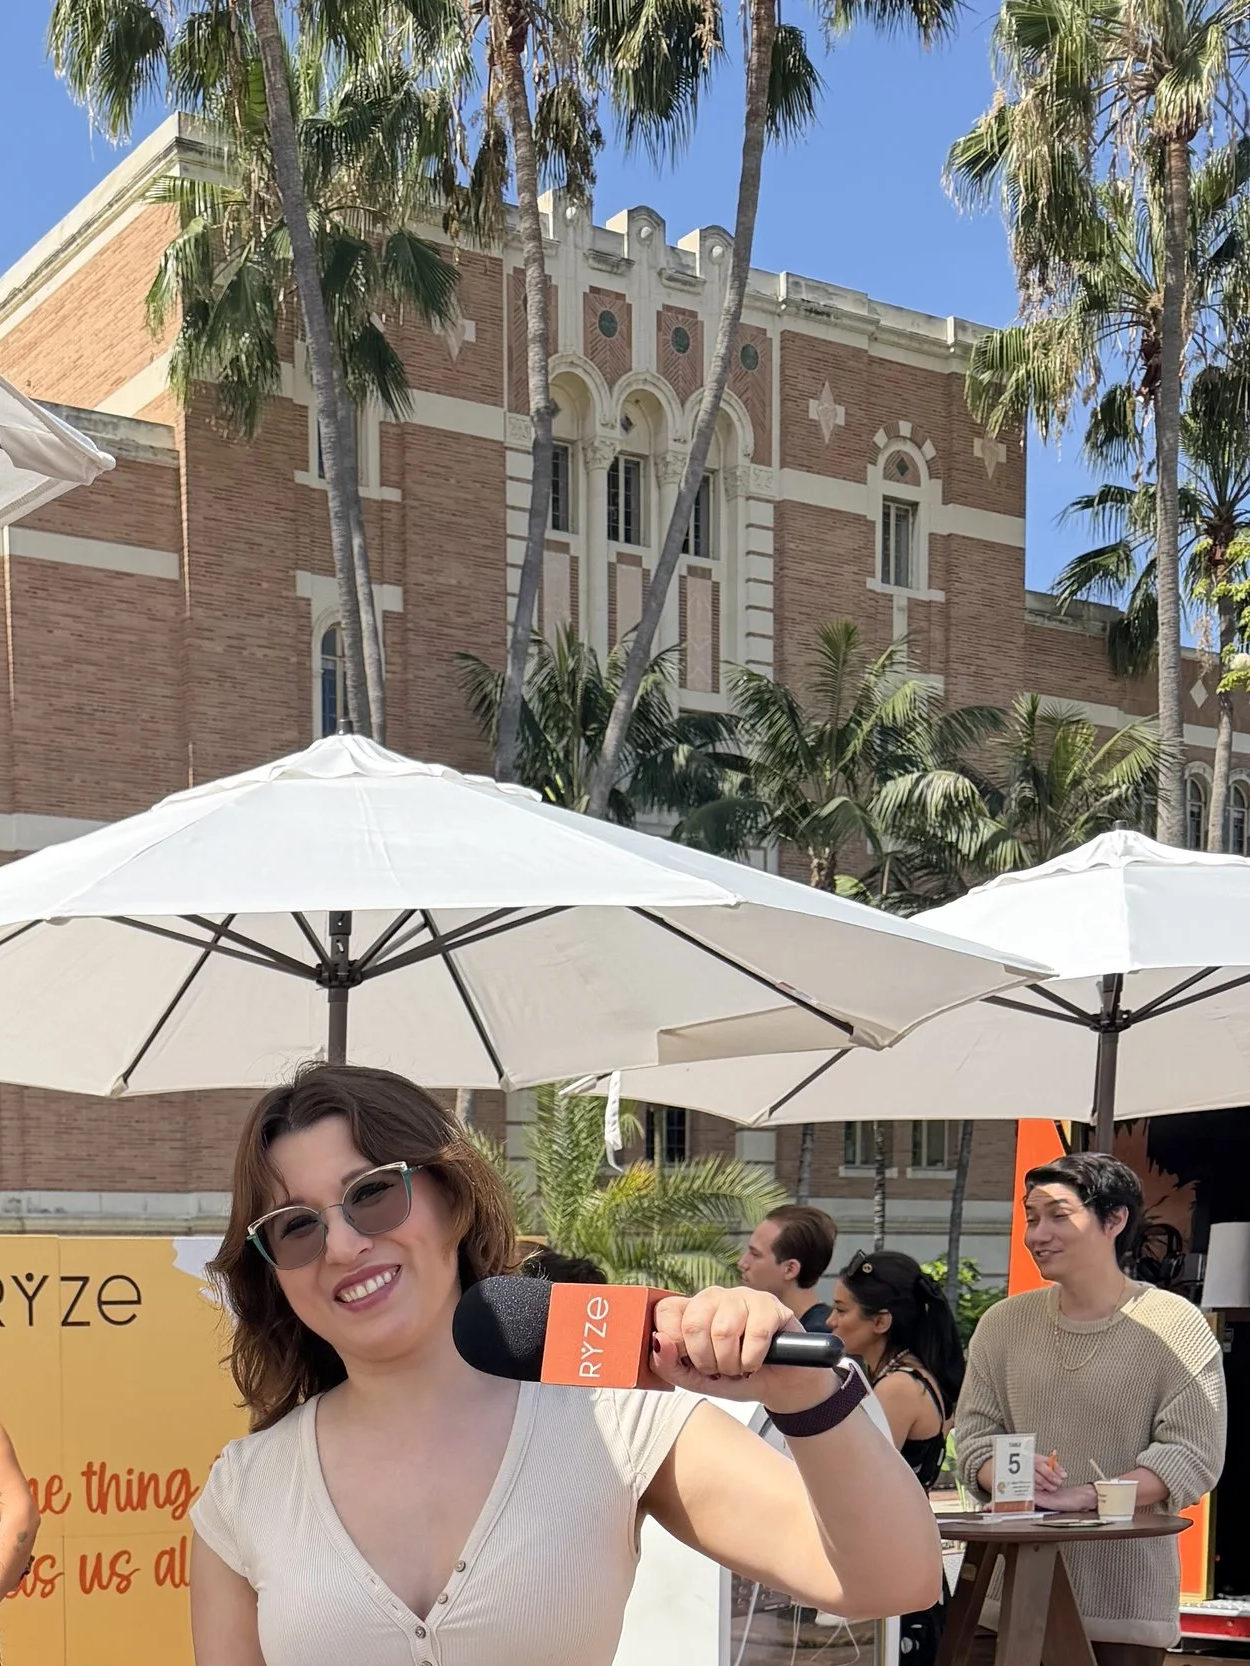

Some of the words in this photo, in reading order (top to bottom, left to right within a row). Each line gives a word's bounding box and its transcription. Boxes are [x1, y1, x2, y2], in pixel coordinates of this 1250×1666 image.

[80, 1461, 200, 1521] thing
[1008, 1453, 1021, 1475] 5
[79, 1550, 141, 1594] us
[154, 1535, 190, 1589] al
